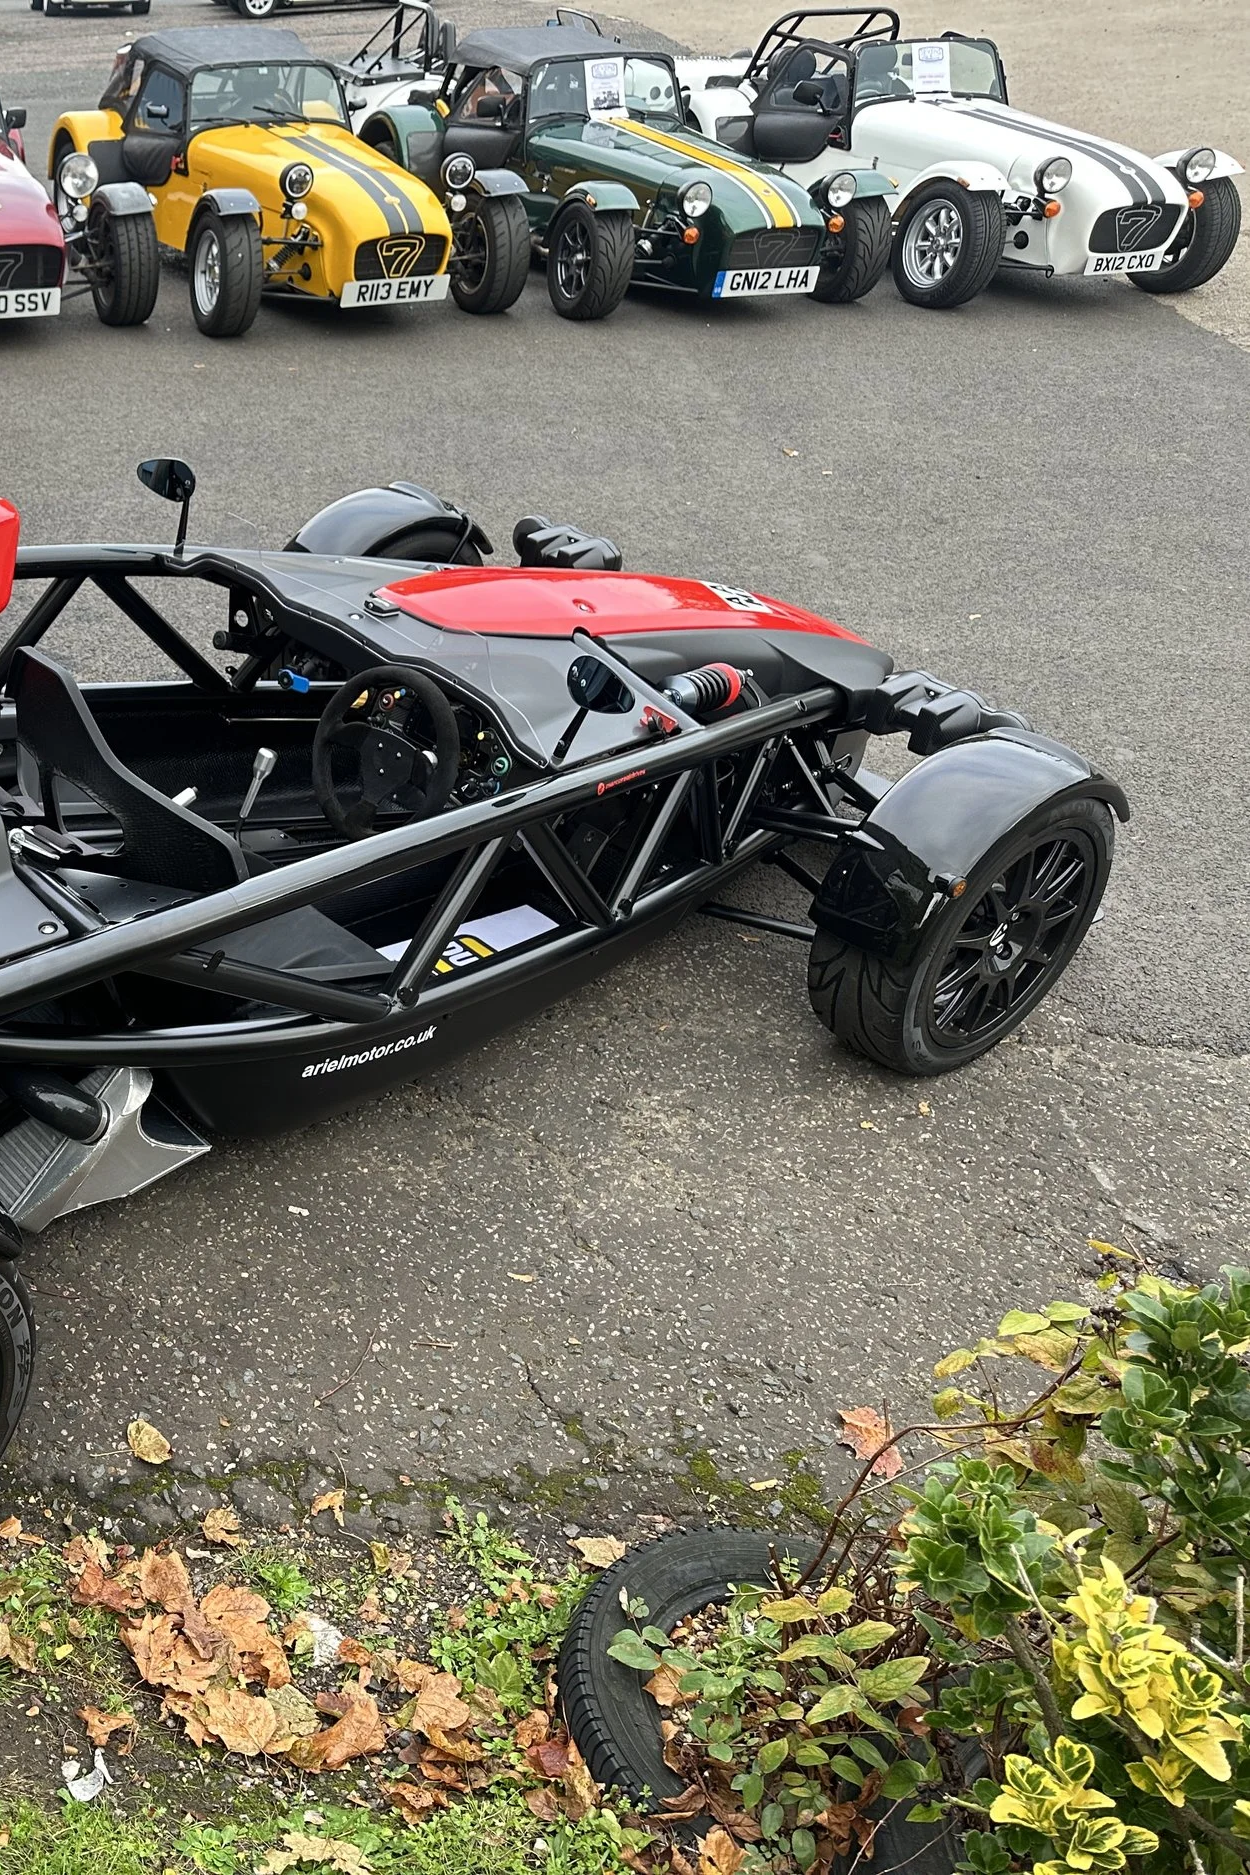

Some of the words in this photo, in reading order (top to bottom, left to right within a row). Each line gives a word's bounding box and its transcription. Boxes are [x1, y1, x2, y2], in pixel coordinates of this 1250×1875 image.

[1093, 256, 1126, 273] BX12
[1127, 253, 1155, 270] CXO
[356, 282, 392, 303] R113
[395, 279, 435, 299] EMY
[729, 271, 772, 291] GN12
[774, 269, 810, 289] LHA
[14, 291, 52, 313] SSV
[301, 1025, 438, 1078] arielmotor.co.uk
